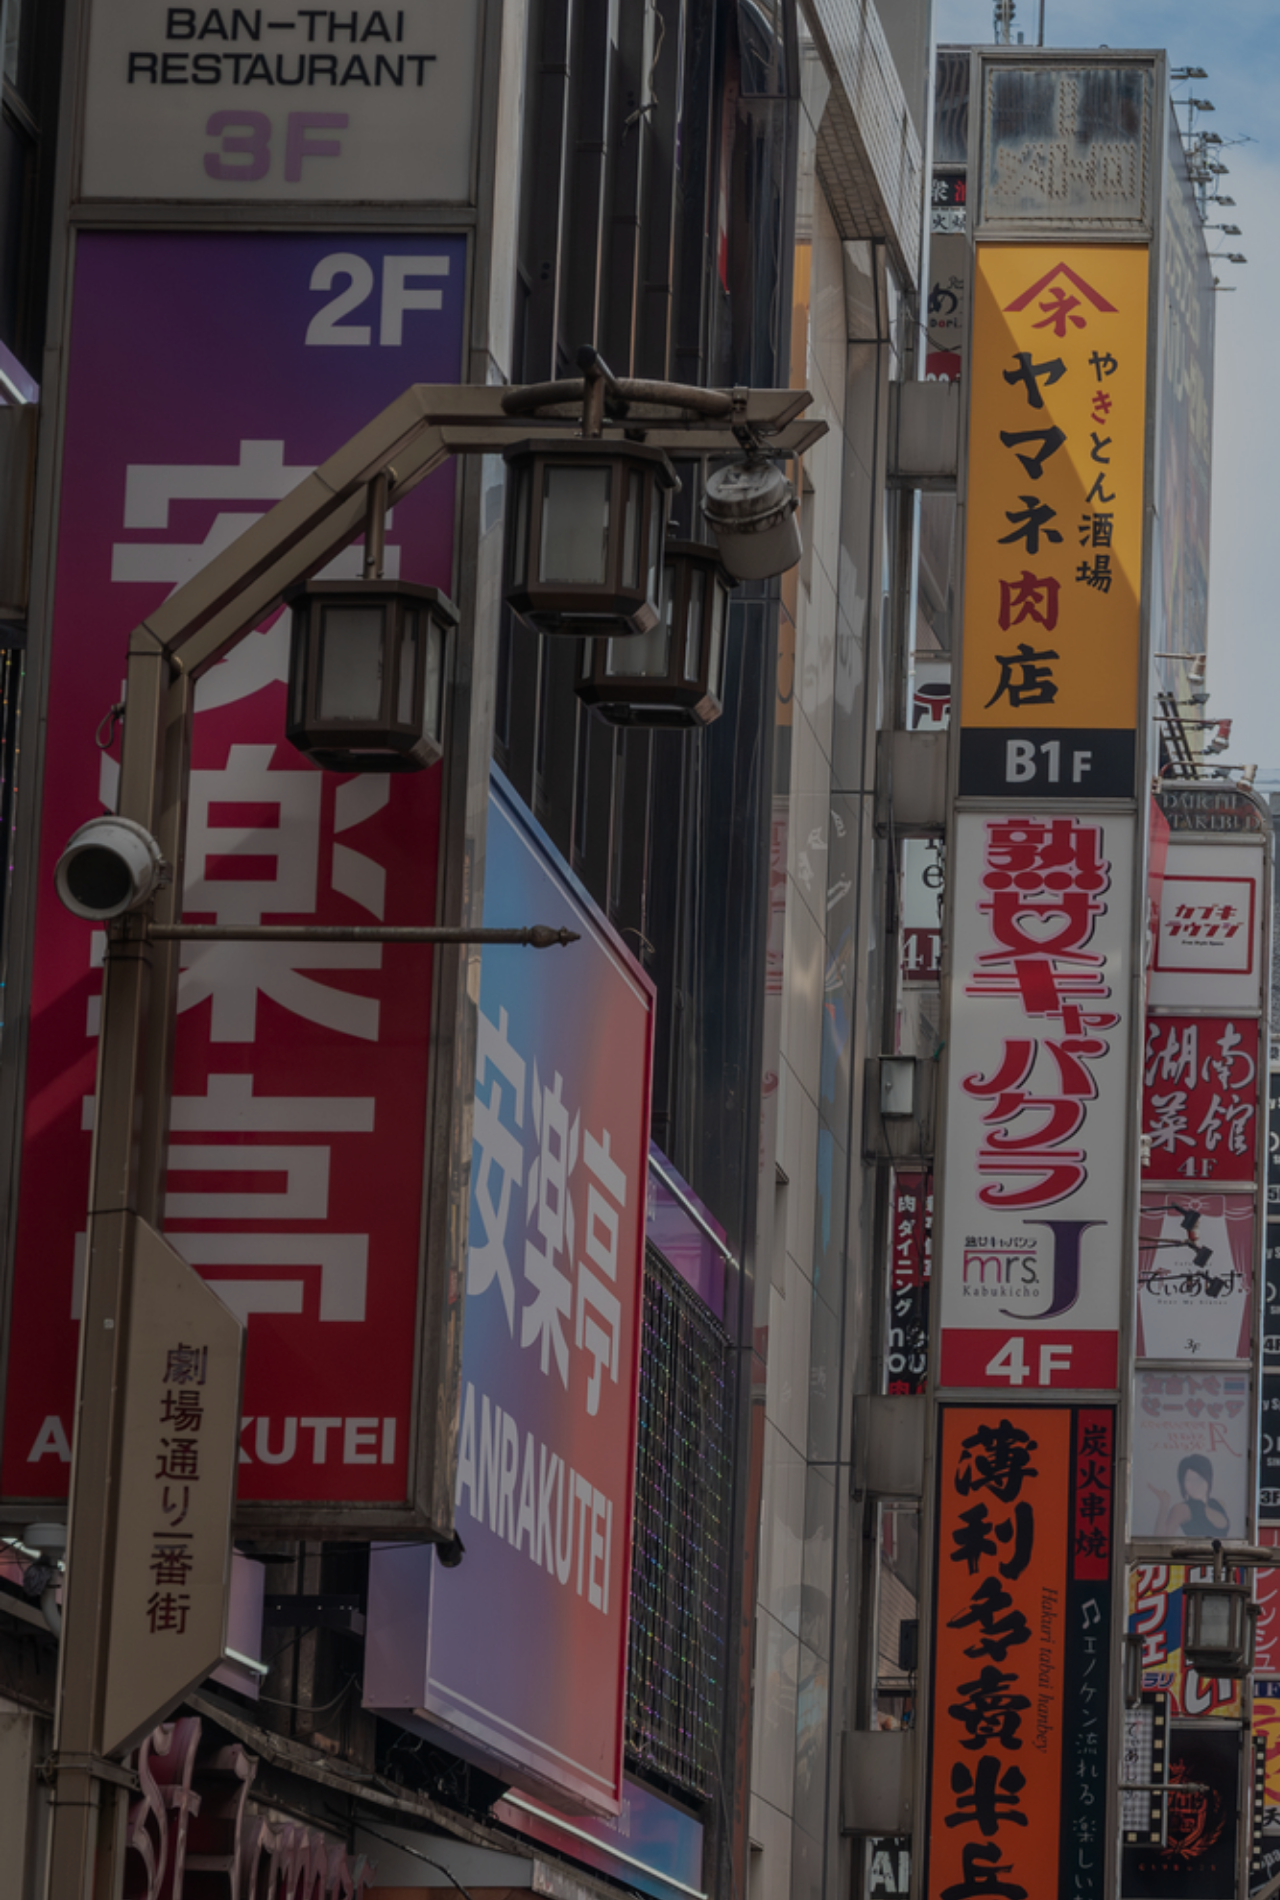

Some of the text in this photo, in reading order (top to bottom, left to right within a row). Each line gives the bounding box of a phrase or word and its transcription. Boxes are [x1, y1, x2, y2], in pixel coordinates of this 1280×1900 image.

[165, 7, 405, 43] BAN-THAI
[125, 52, 437, 88] RESTAURANT
[202, 108, 350, 183] 3F
[303, 251, 451, 347] 2F
[1031, 286, 1088, 338] ネ
[1074, 350, 1119, 594] やきとん酒場
[983, 351, 1068, 710] ヤマネ肉店
[1004, 739, 1093, 784] B1F
[1164, 921, 1245, 938] ラウンジ
[1174, 903, 1238, 921] カブキ
[1176, 1156, 1219, 1179] 4F
[962, 1284, 1040, 1297] Kabukicho
[984, 1335, 1074, 1387] 4F
[146, 1342, 209, 1636] 劇場通り一番街
[455, 1382, 614, 1616] ANRAKUTEI
[1073, 1425, 1113, 1561] 炭火串焼
